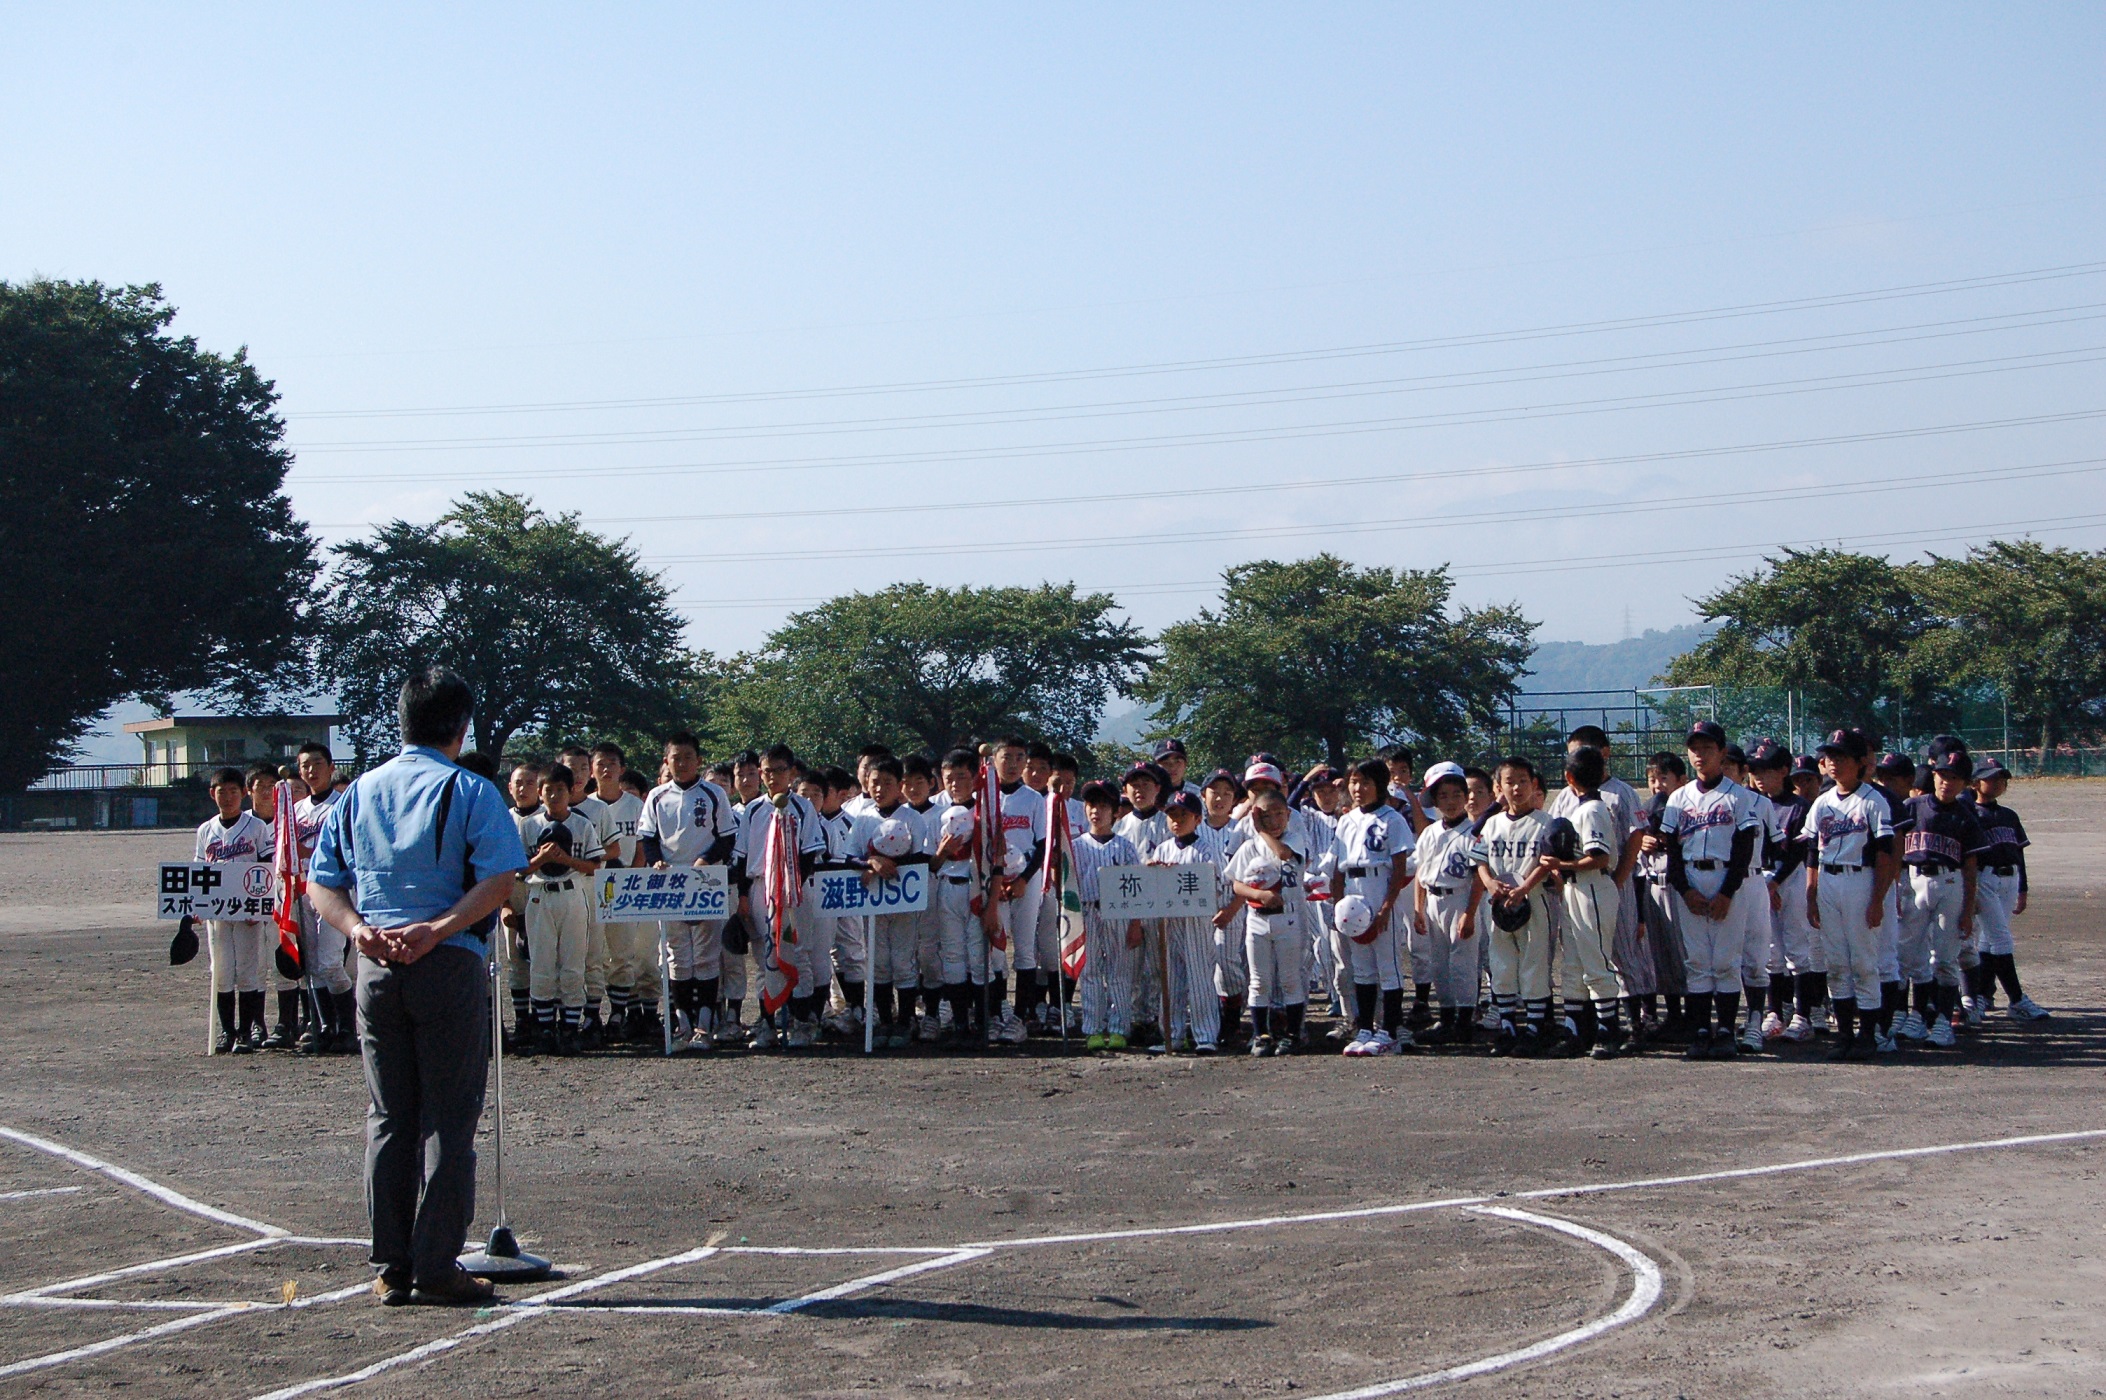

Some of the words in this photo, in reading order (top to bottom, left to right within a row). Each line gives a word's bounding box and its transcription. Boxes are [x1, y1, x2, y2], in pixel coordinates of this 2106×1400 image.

[206, 836, 255, 862] Tanaka
[162, 866, 222, 895] 田中
[251, 869, 265, 884] T
[621, 873, 688, 890] 北御牧
[1119, 871, 1199, 898] 祢津
[162, 896, 275, 916] スポーツ少年団
